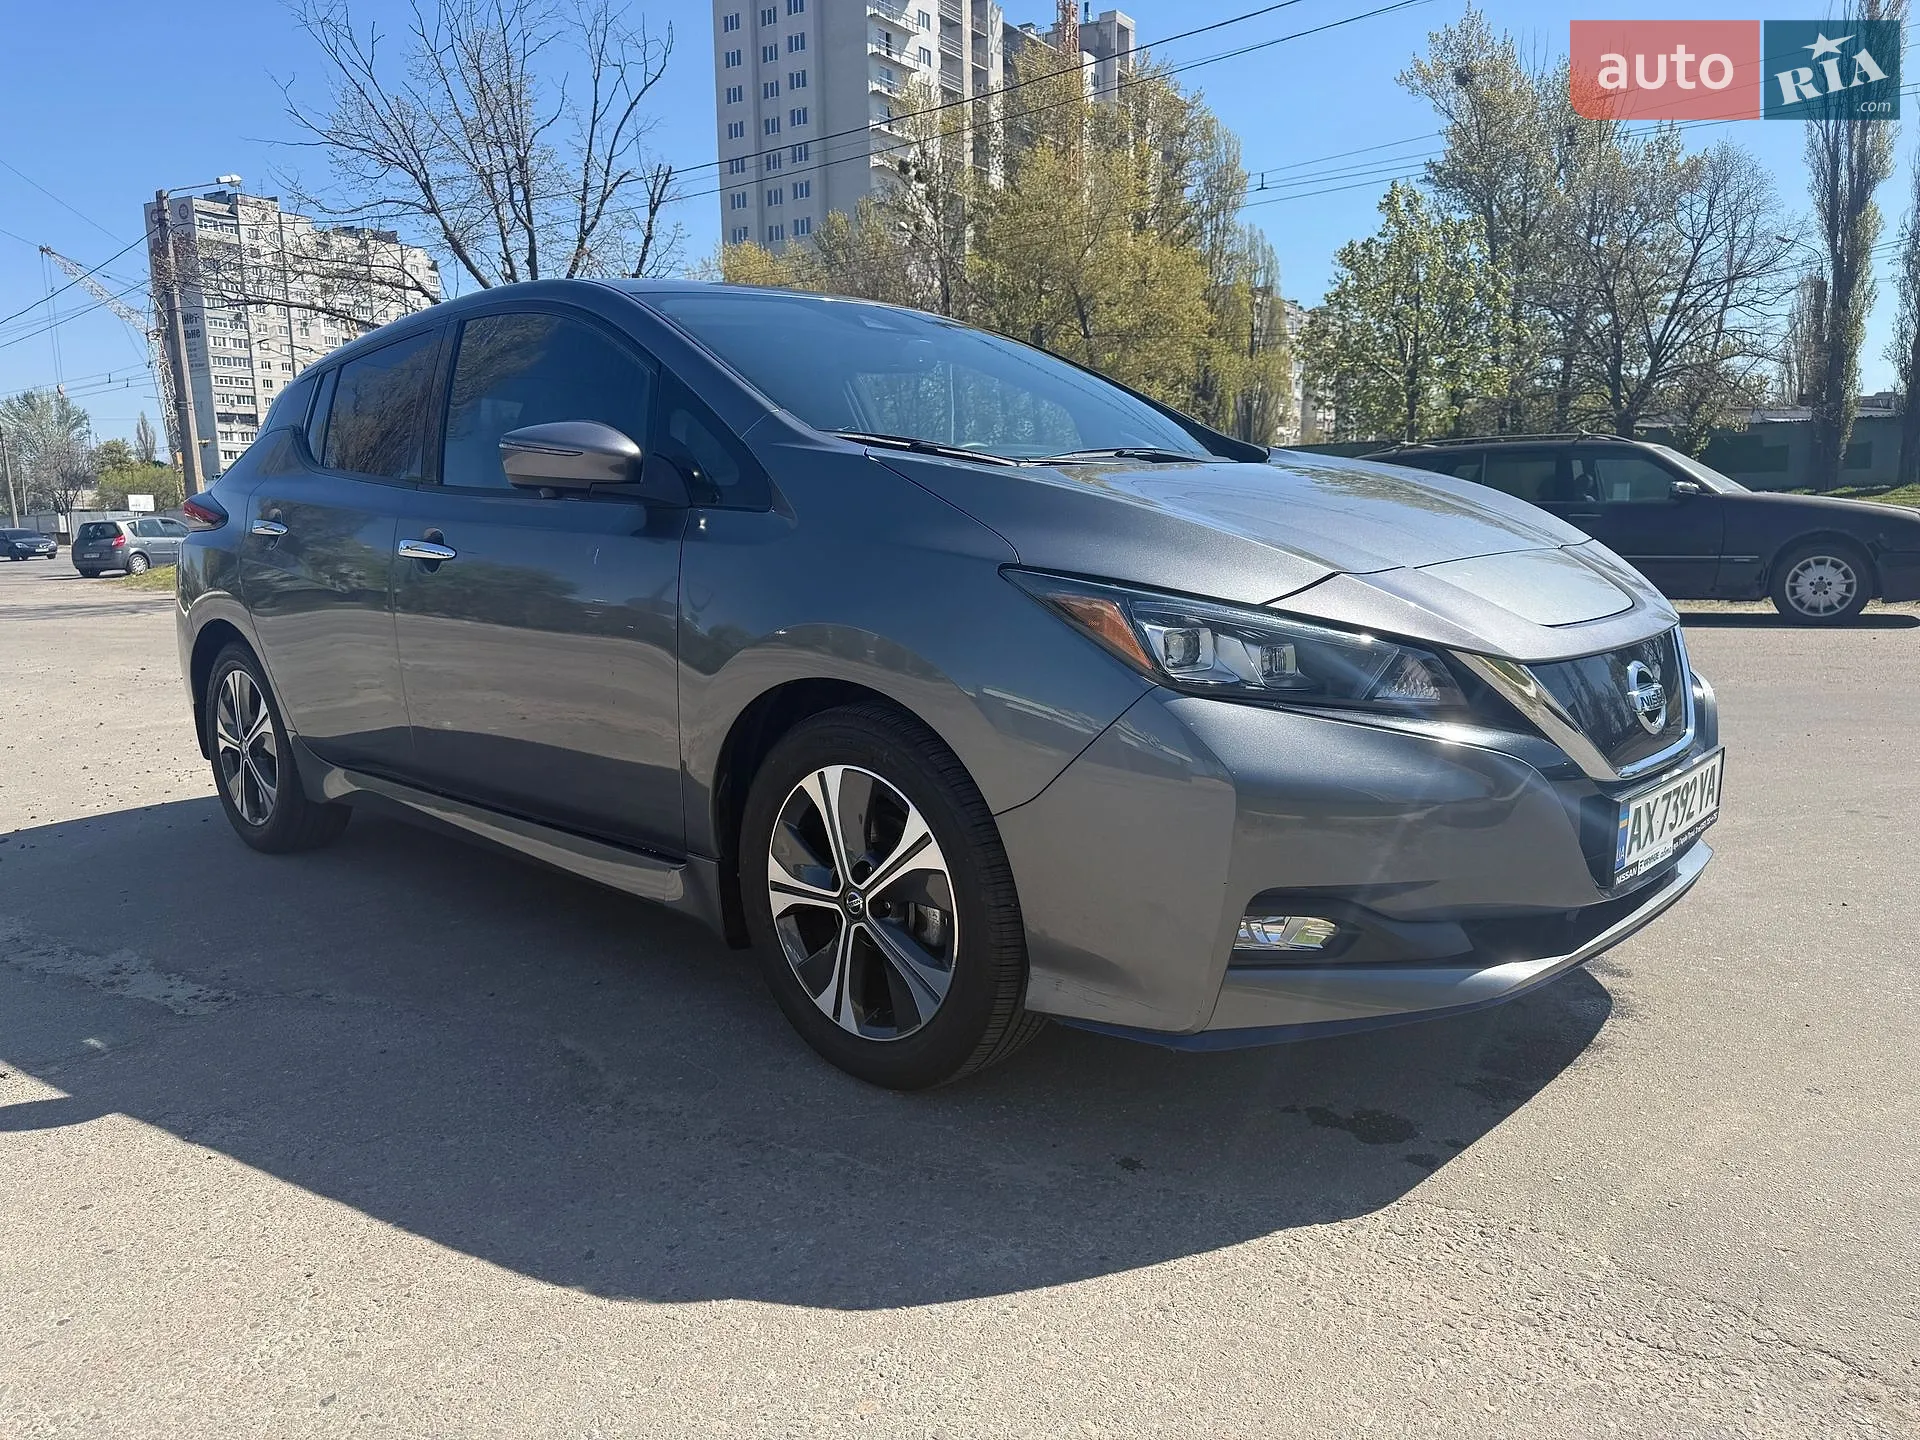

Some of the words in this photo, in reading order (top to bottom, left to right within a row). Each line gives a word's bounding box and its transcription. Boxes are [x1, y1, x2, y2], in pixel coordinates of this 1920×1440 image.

[1627, 797, 1659, 857] AX
[1658, 776, 1697, 840] 7392
[1699, 764, 1716, 814] YA
[1615, 865, 1638, 885] NISSAN
